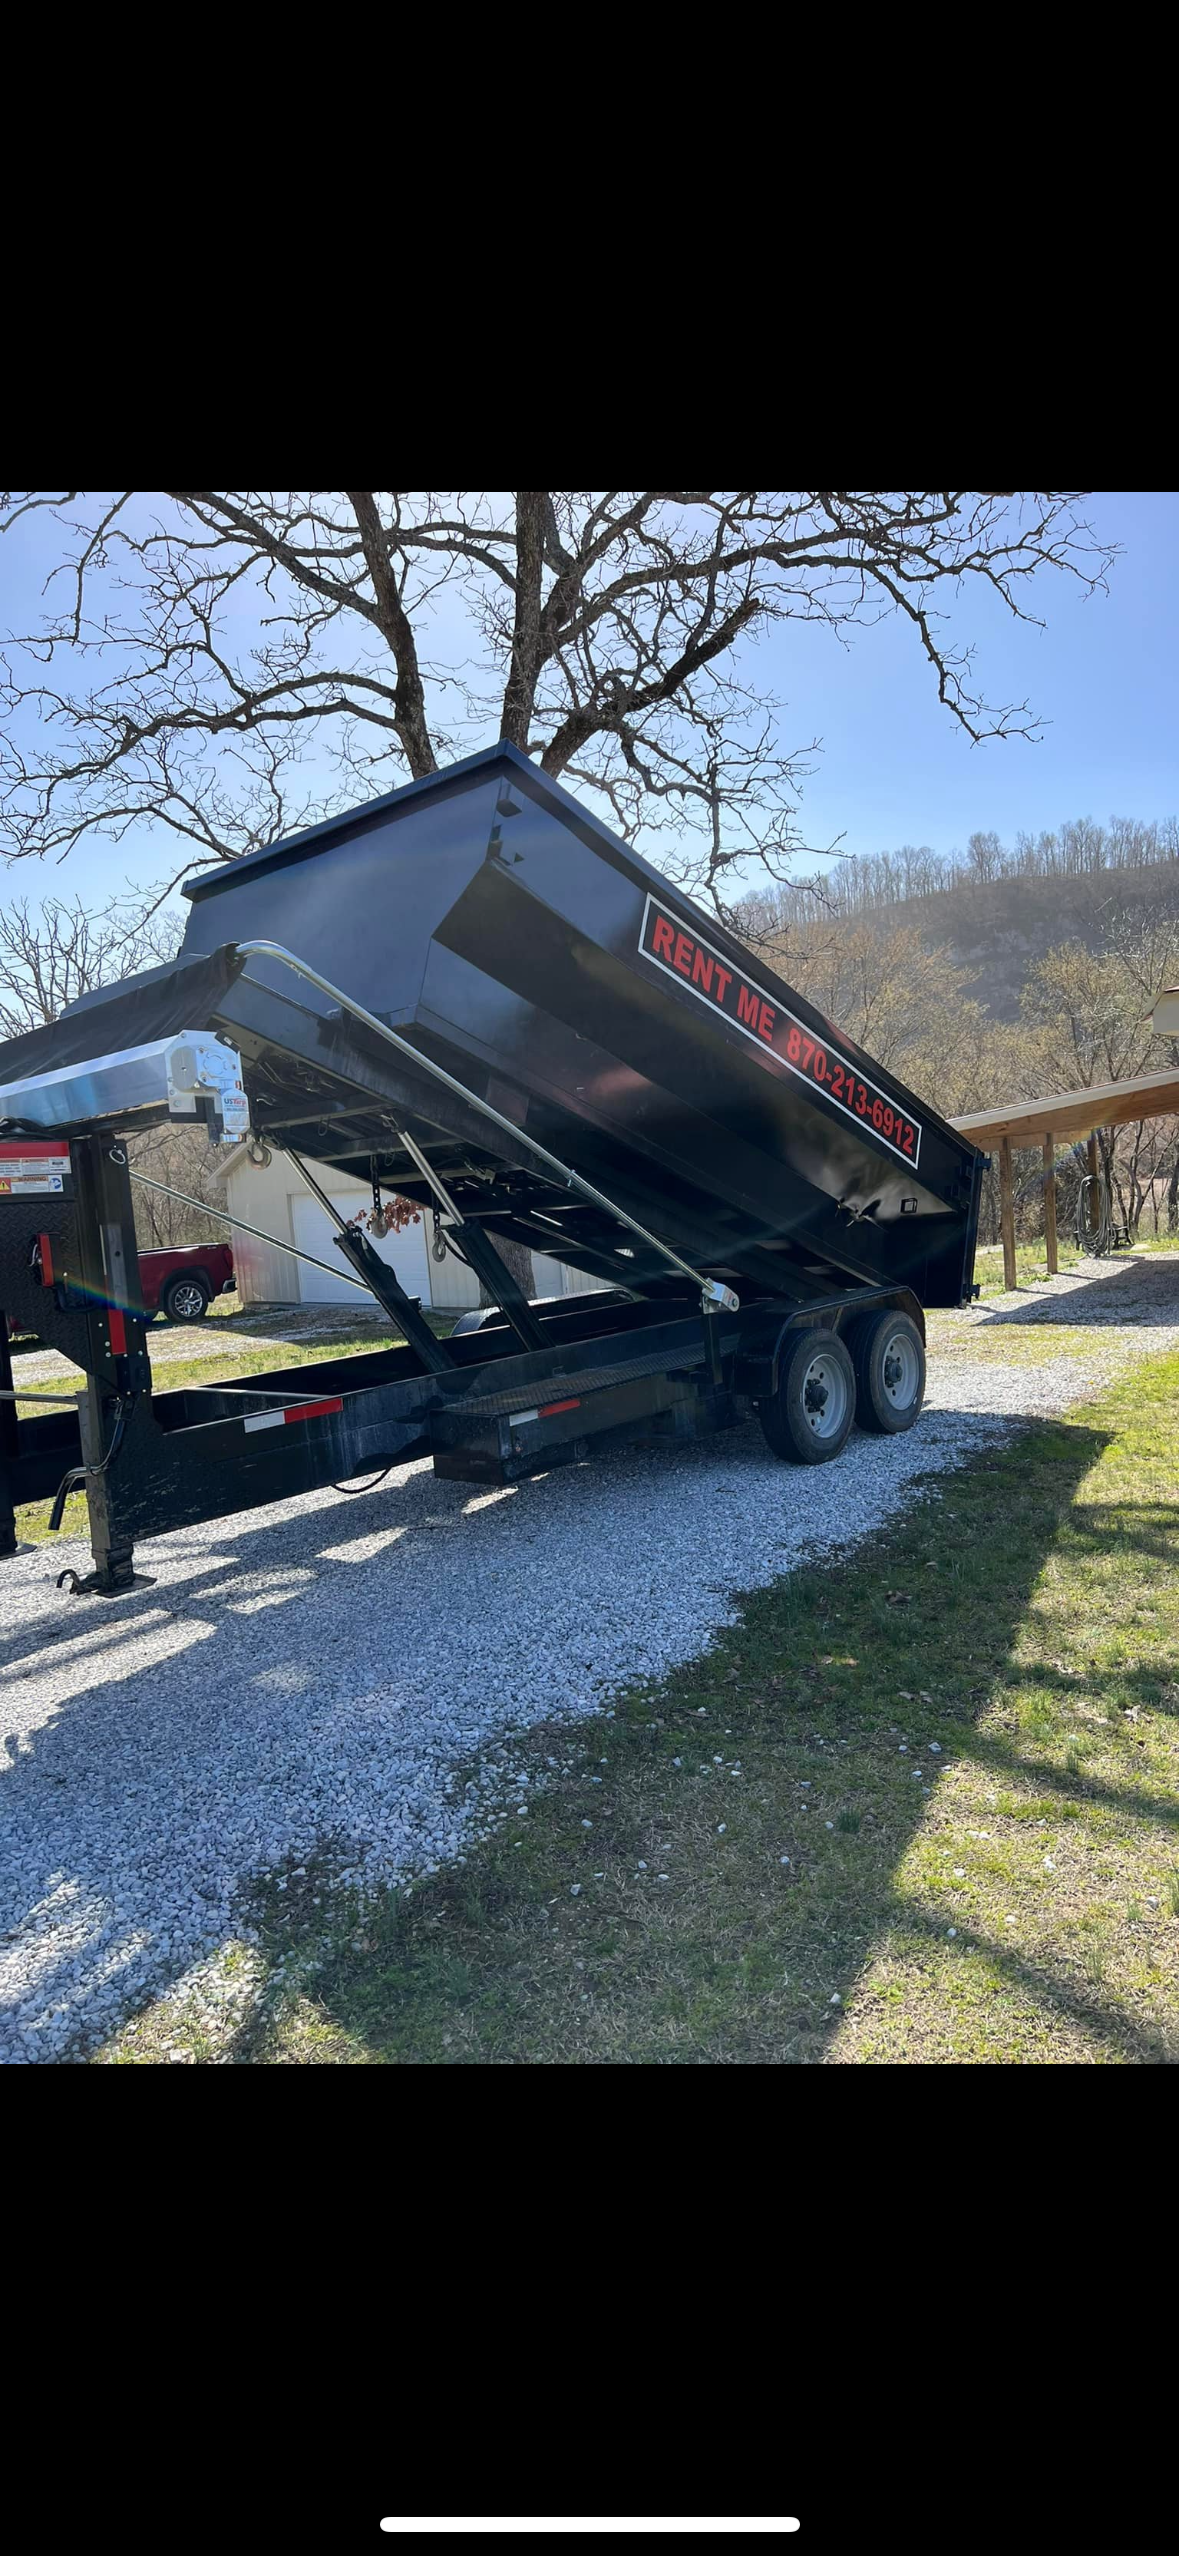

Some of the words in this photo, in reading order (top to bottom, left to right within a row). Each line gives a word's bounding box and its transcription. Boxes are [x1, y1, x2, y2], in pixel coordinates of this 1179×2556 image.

[653, 915, 732, 1003] RENT
[737, 985, 776, 1041] ME
[787, 1028, 914, 1155] 870-213-6912
